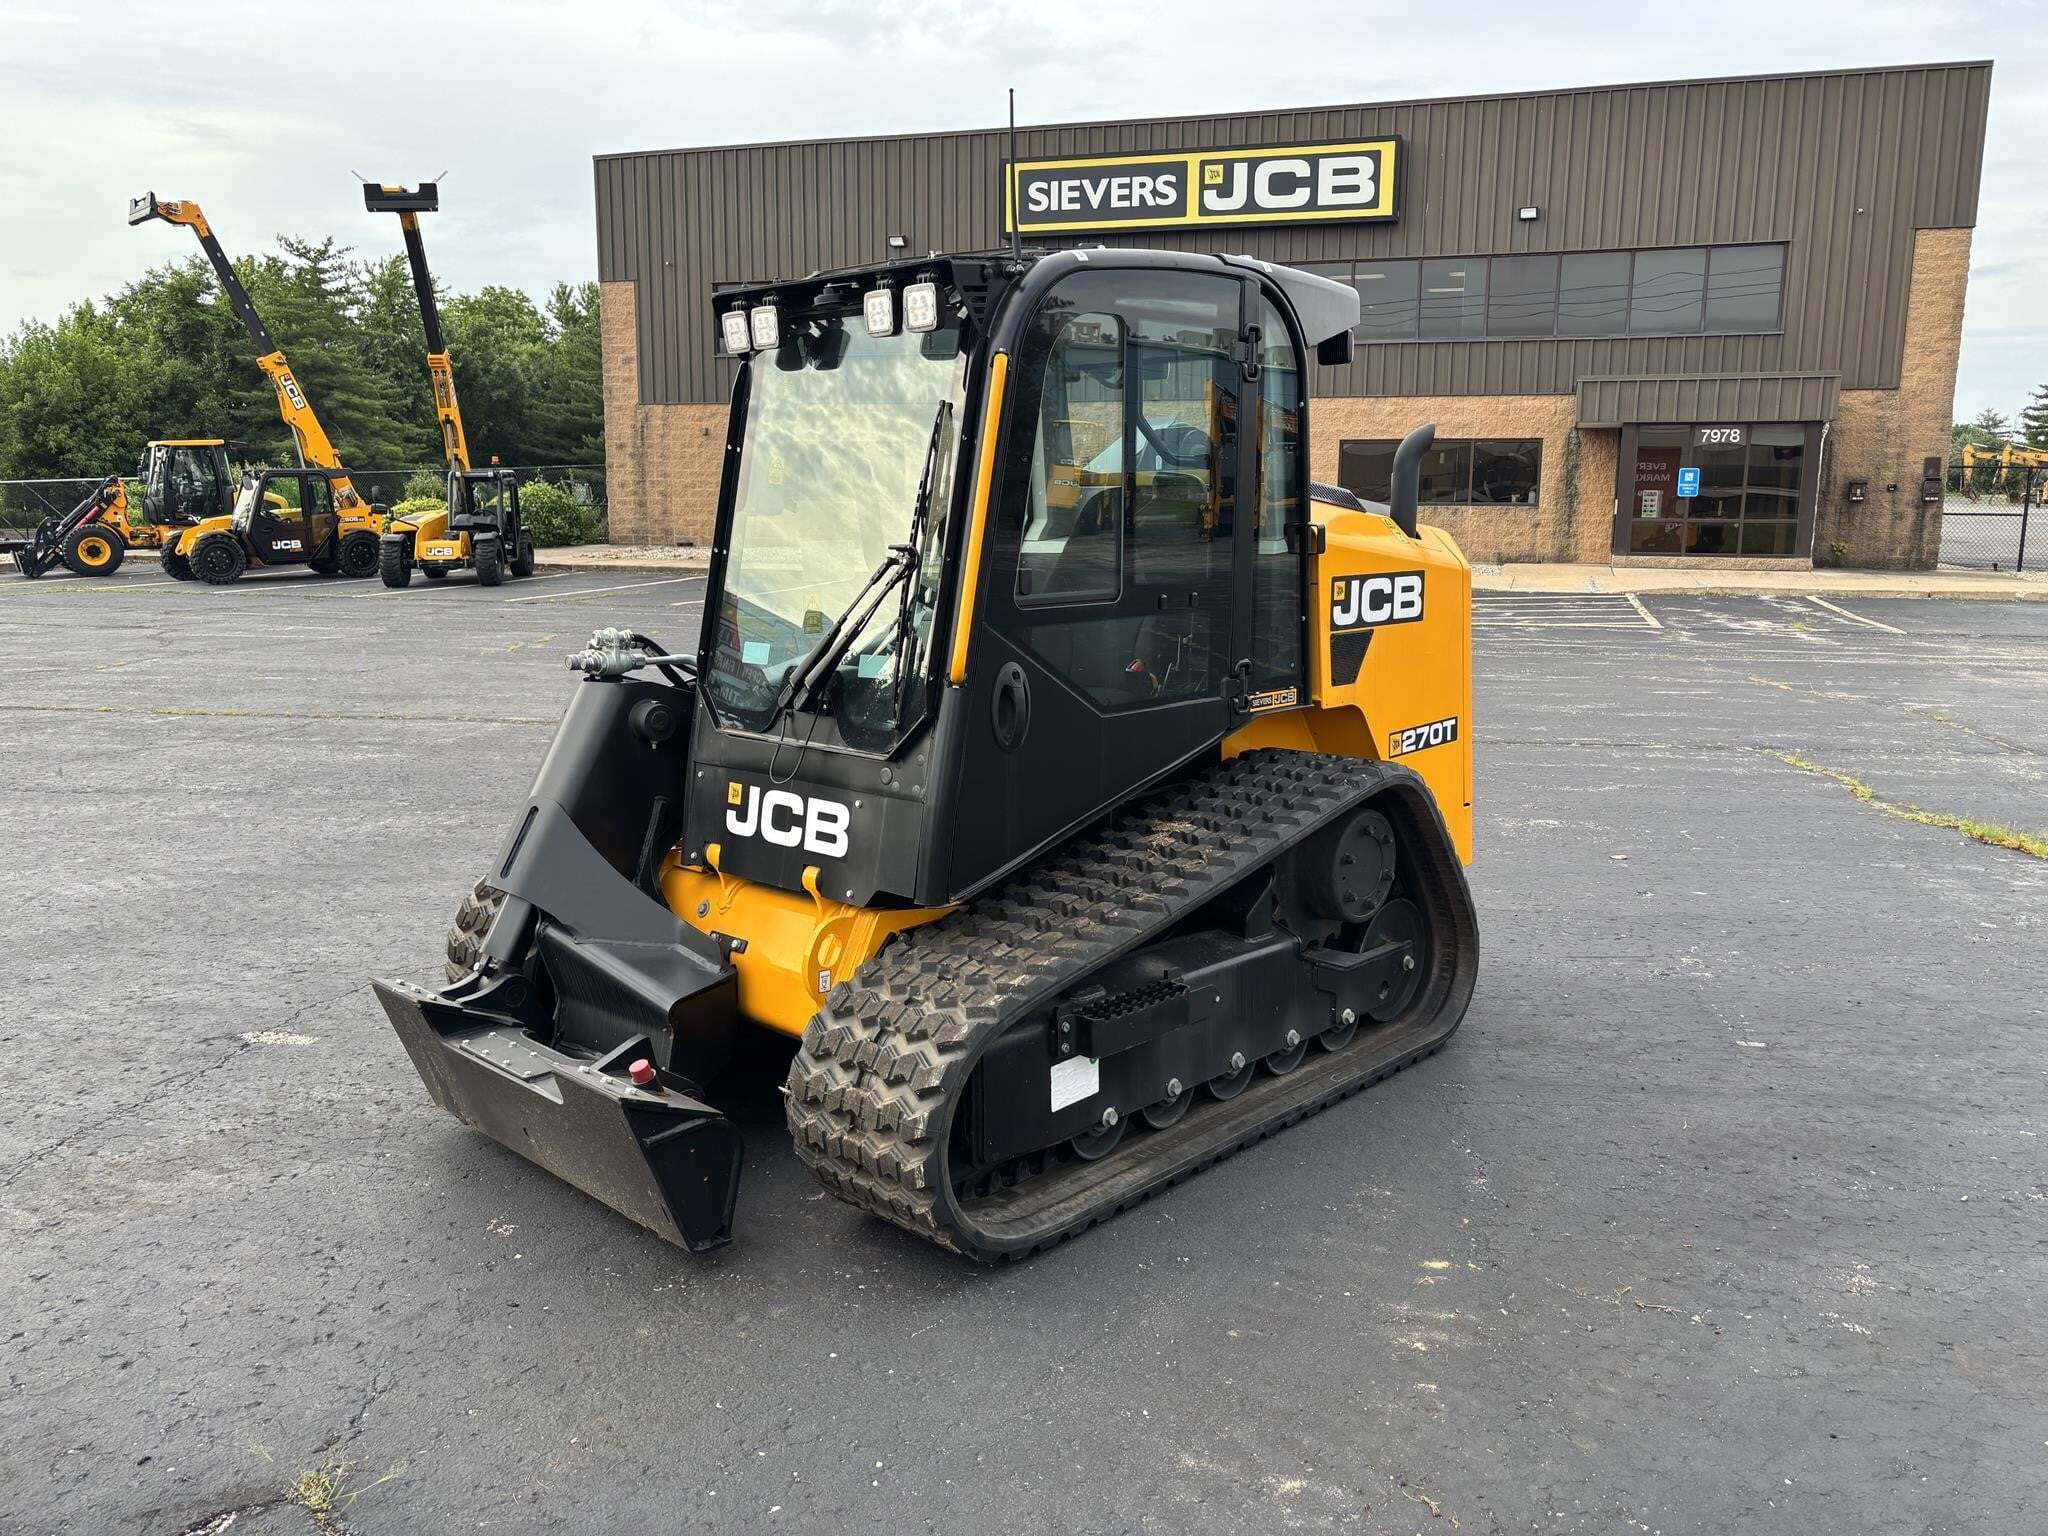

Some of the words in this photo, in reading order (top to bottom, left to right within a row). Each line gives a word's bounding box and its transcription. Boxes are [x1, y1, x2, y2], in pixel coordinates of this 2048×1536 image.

[1027, 174, 1178, 212] SIEVERS
[1203, 155, 1375, 211] JCB
[280, 374, 305, 410] JCB
[1701, 429, 1741, 443] 7978
[272, 539, 302, 550] JCB
[427, 547, 453, 556] JCB
[1333, 575, 1422, 626] JCB
[1274, 692, 1295, 704] JCB
[1402, 719, 1456, 753] 270T
[726, 785, 850, 858] JCB
